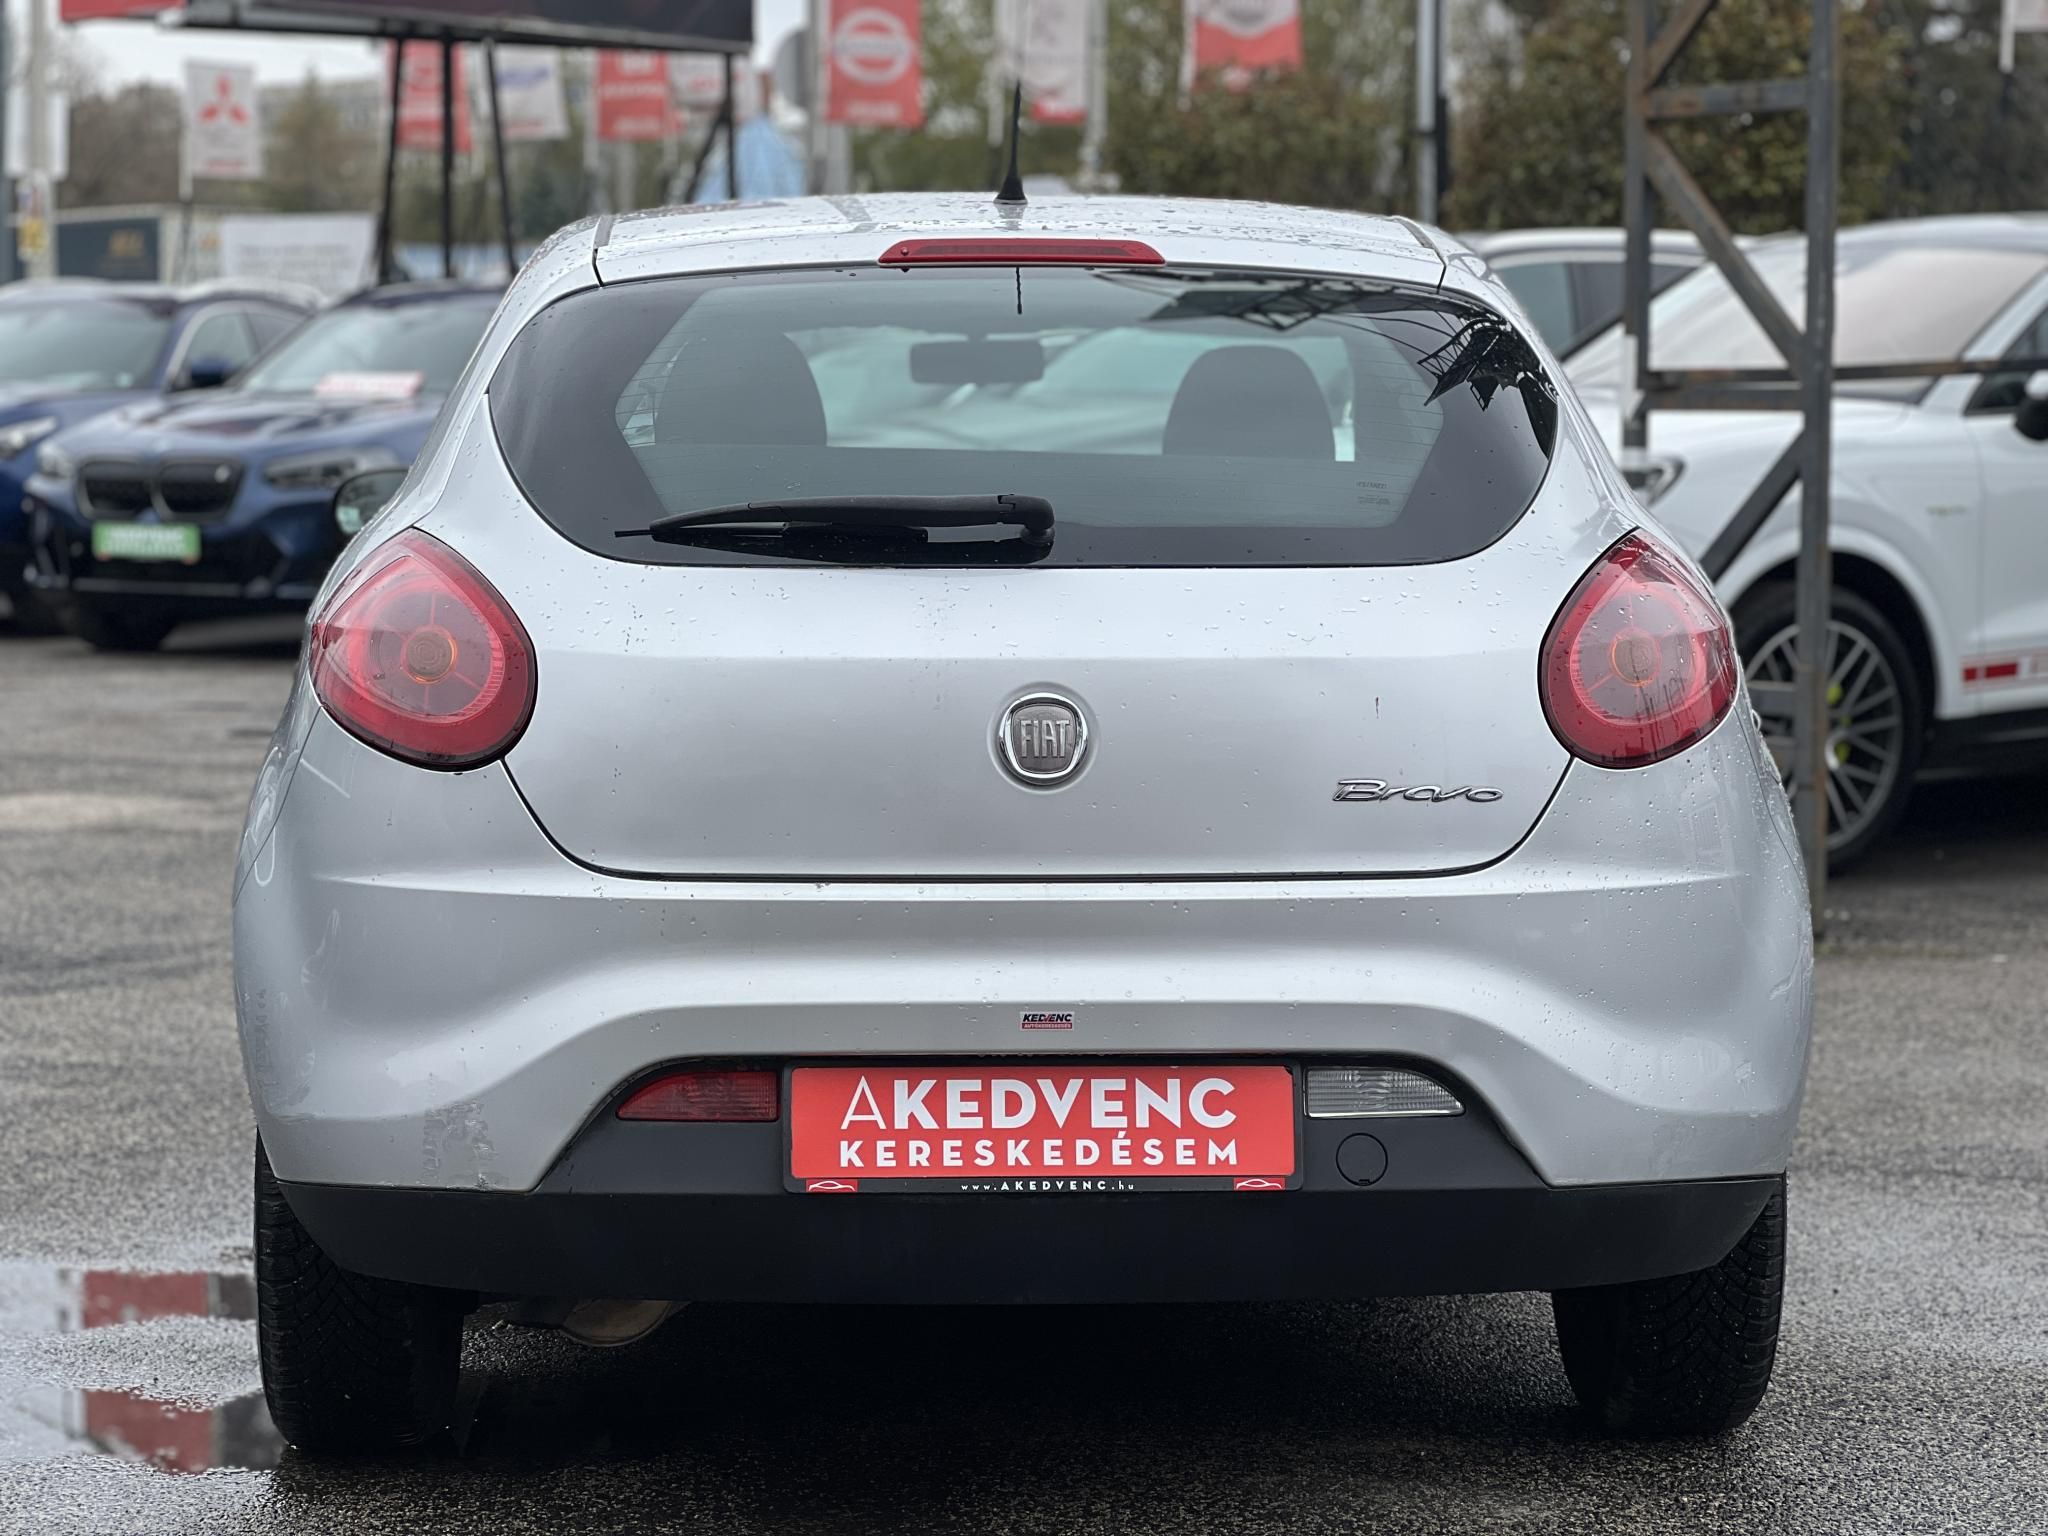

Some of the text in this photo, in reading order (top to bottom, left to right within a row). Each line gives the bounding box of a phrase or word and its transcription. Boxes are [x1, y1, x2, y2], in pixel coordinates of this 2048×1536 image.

[1020, 719, 1070, 758] FIAT
[1332, 779, 1503, 802] Bravo
[1022, 1013, 1073, 1022] KEDVENC
[839, 1130, 1238, 1168] KERESKEDÉSEM
[961, 1180, 1135, 1191] www.AKEDVENC.hu
